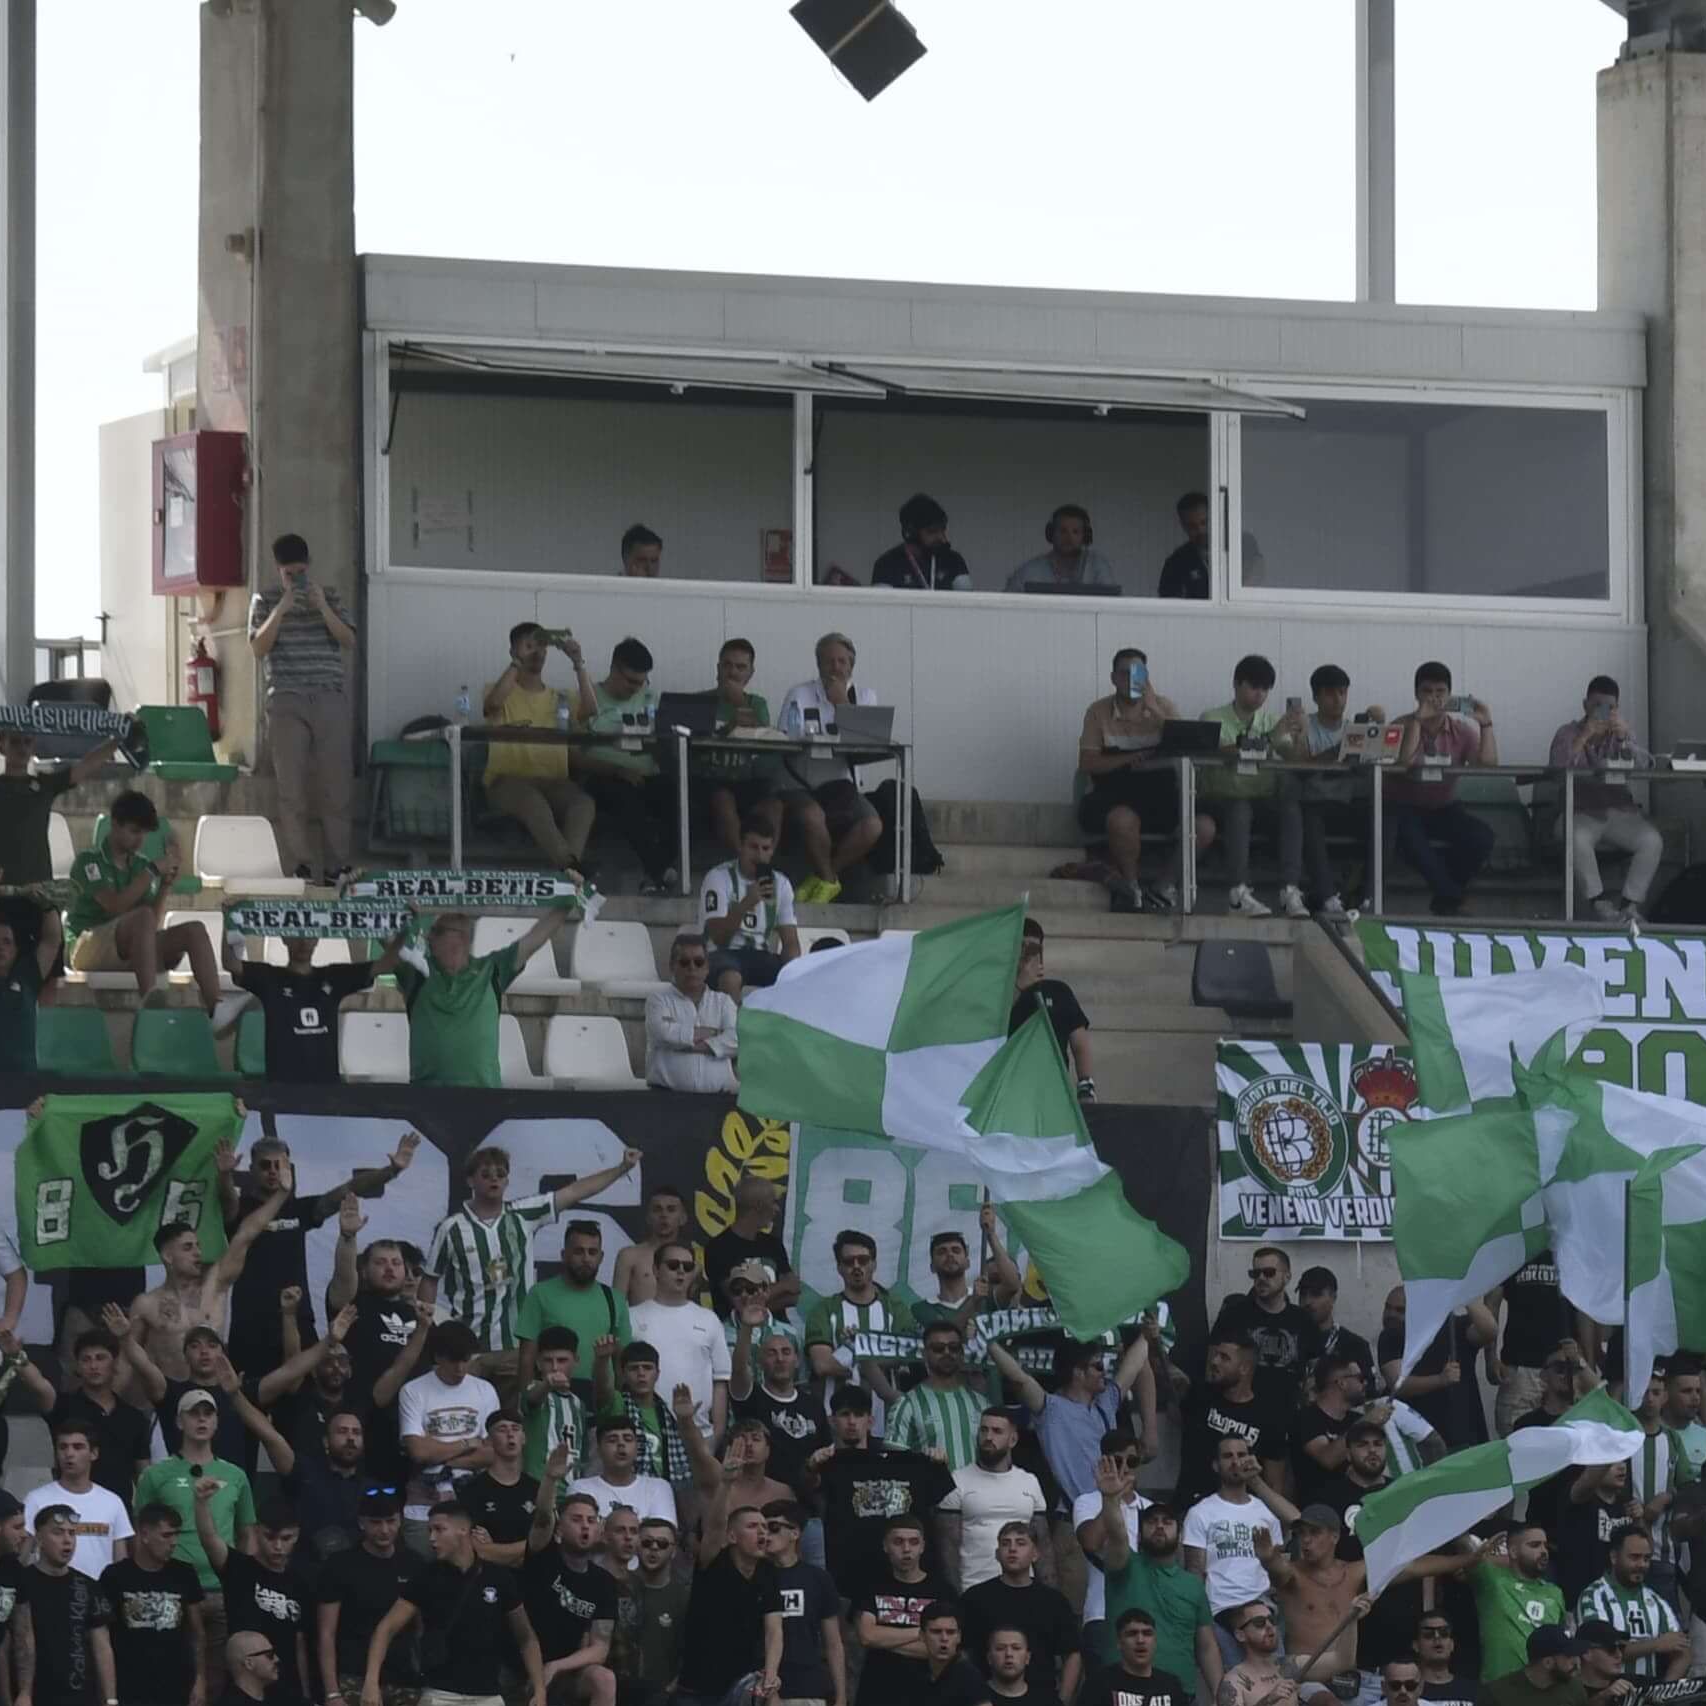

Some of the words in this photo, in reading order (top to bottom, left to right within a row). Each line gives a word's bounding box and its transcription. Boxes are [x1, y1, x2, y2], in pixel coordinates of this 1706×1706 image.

[374, 879, 455, 897] REAL
[477, 878, 556, 897] BETIS
[241, 911, 320, 930] REAL
[1280, 1080, 1305, 1096] DEL
[1239, 1194, 1324, 1228] VENENO
